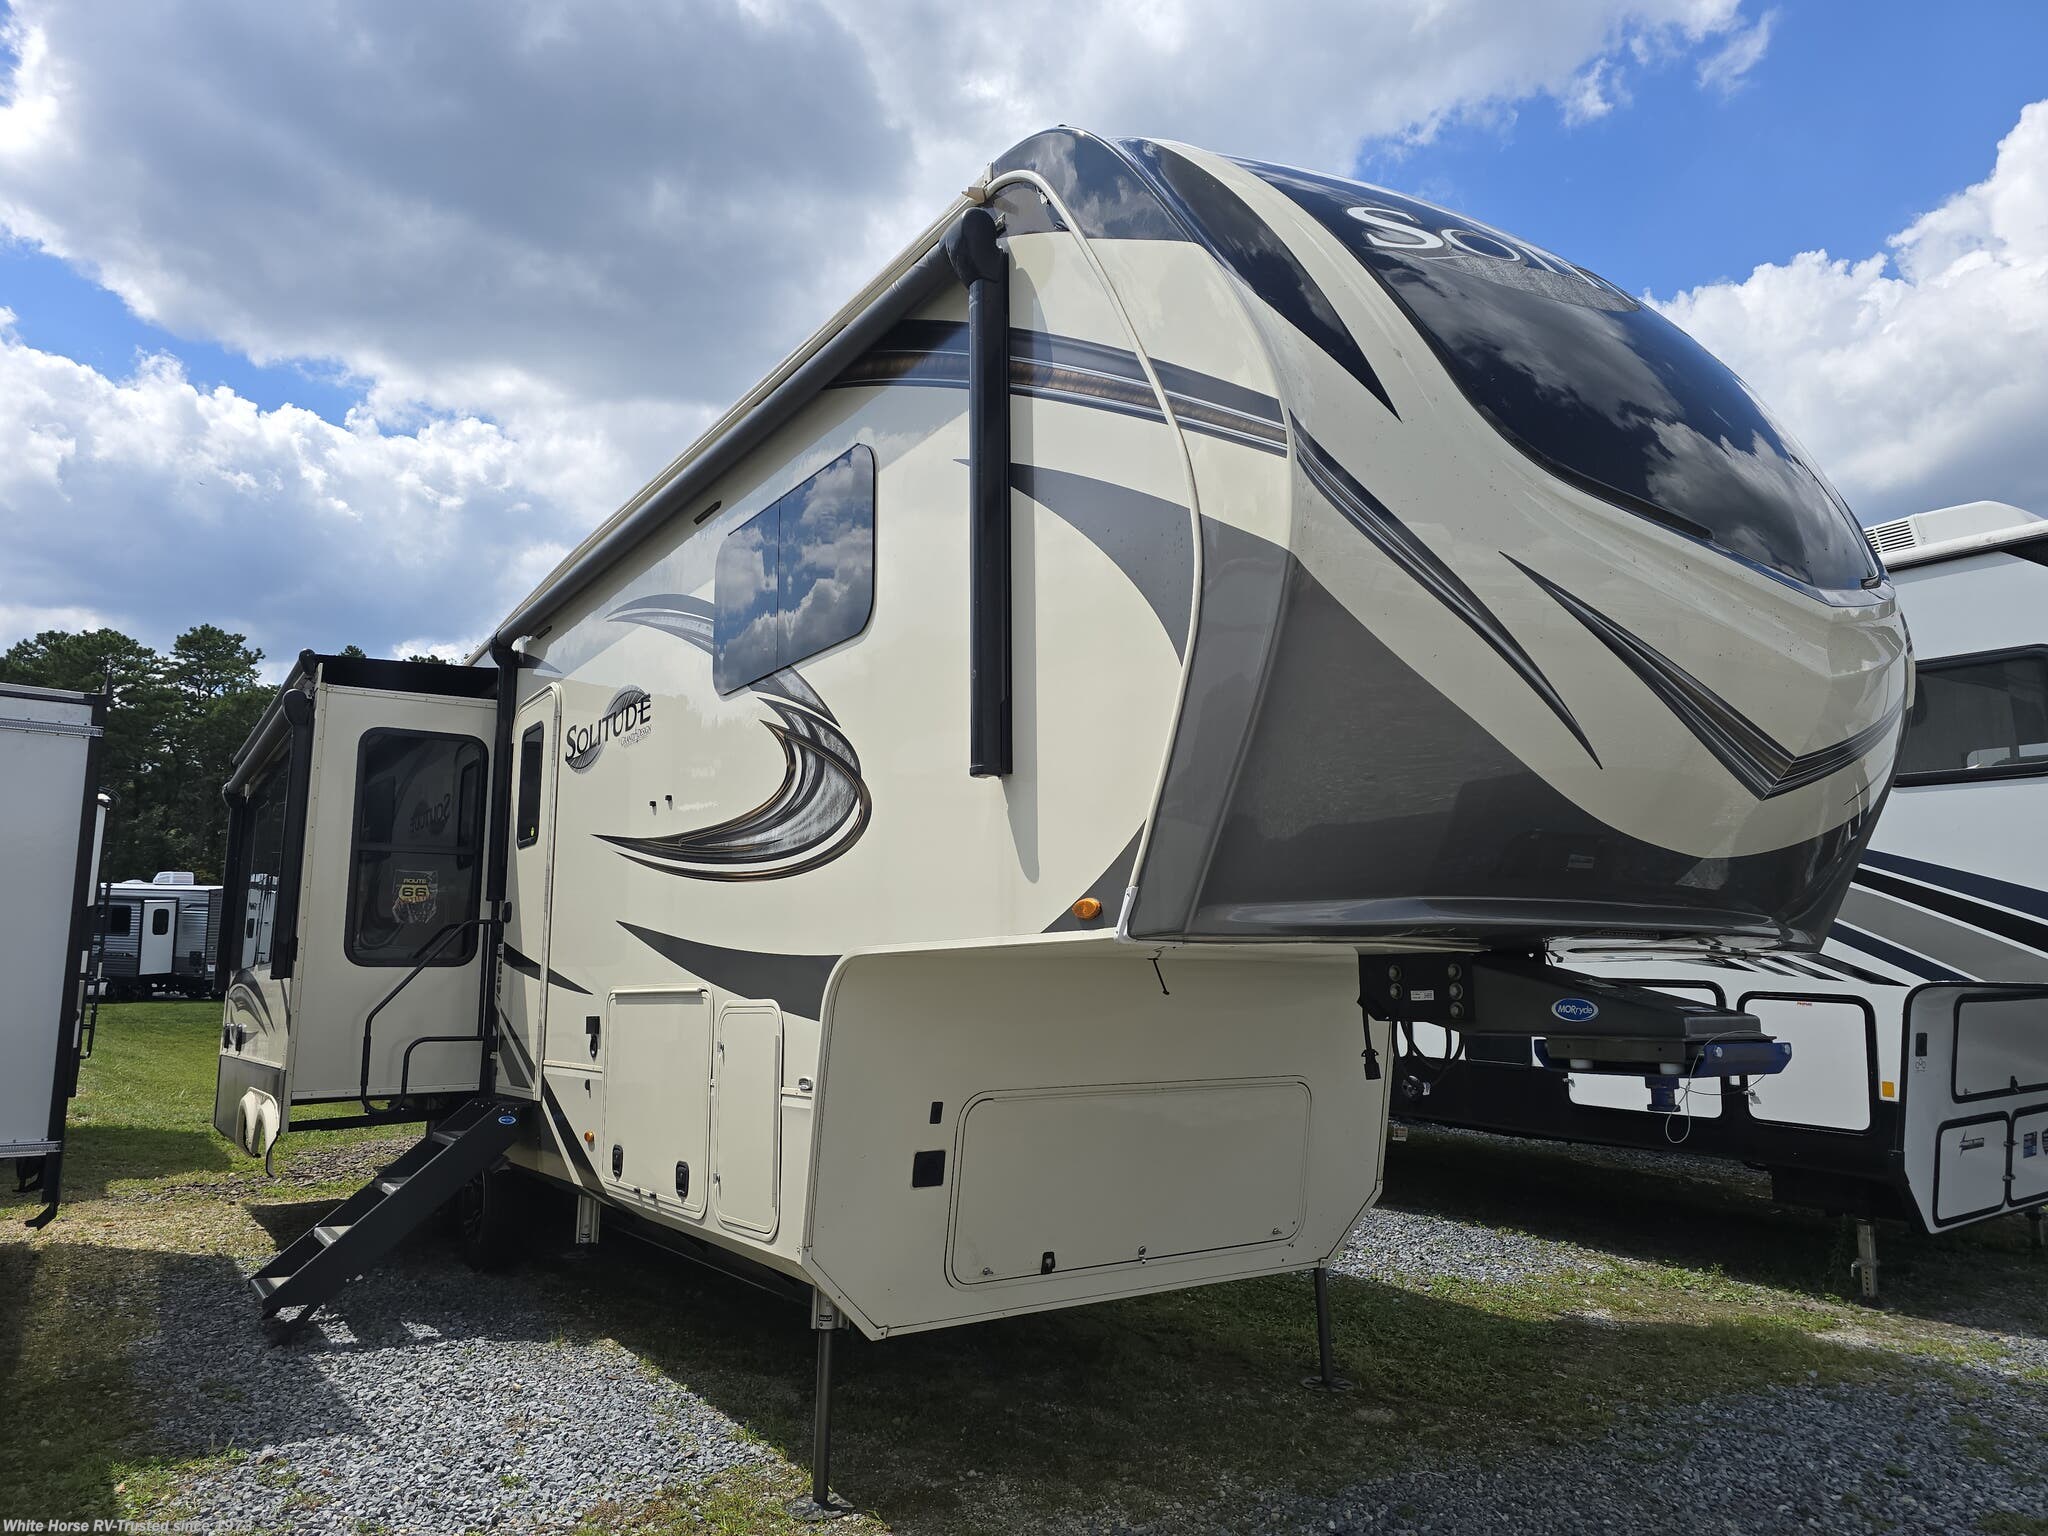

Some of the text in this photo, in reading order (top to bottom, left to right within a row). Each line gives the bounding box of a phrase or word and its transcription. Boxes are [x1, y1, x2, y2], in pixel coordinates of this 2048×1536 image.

[565, 693, 651, 761] SOLITUDE
[402, 887, 427, 897] 66
[1558, 1004, 1593, 1016] MORryde
